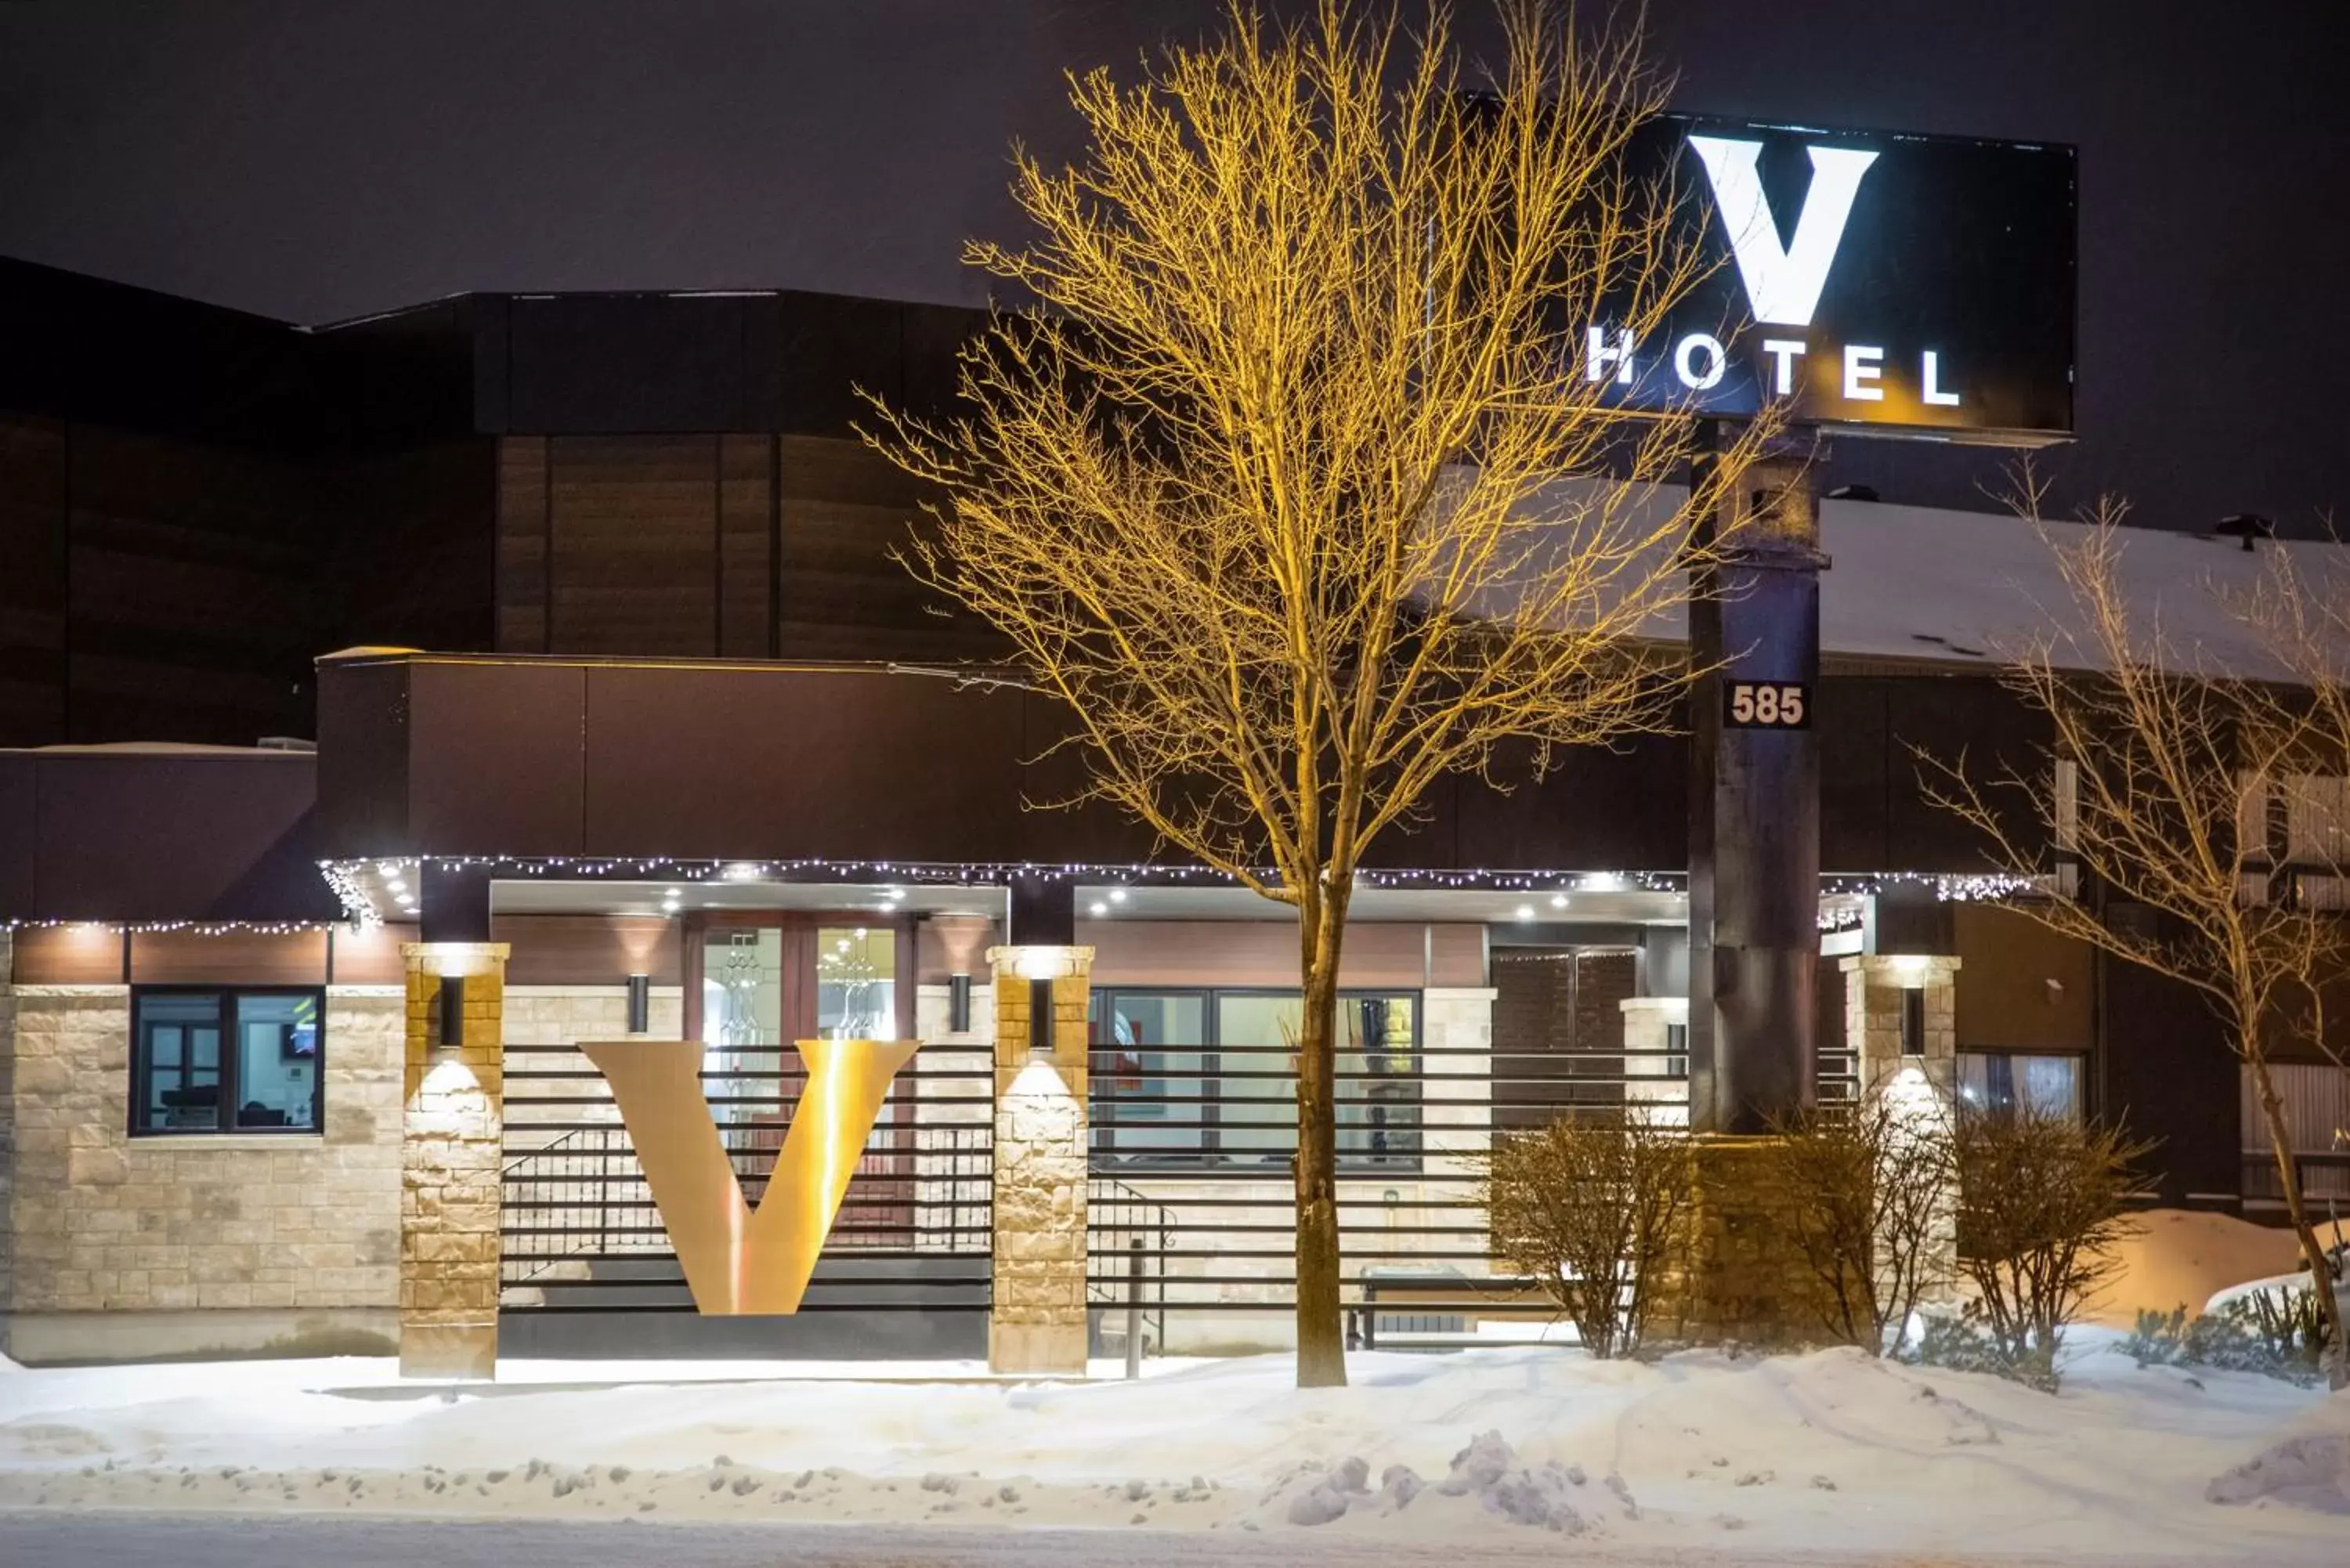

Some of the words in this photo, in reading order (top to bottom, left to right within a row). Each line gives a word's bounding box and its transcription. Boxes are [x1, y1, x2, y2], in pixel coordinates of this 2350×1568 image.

[1688, 135, 1880, 325] V
[1587, 326, 1960, 406] HOTEL
[1732, 685, 1803, 724] 585
[577, 1040, 924, 1316] V
